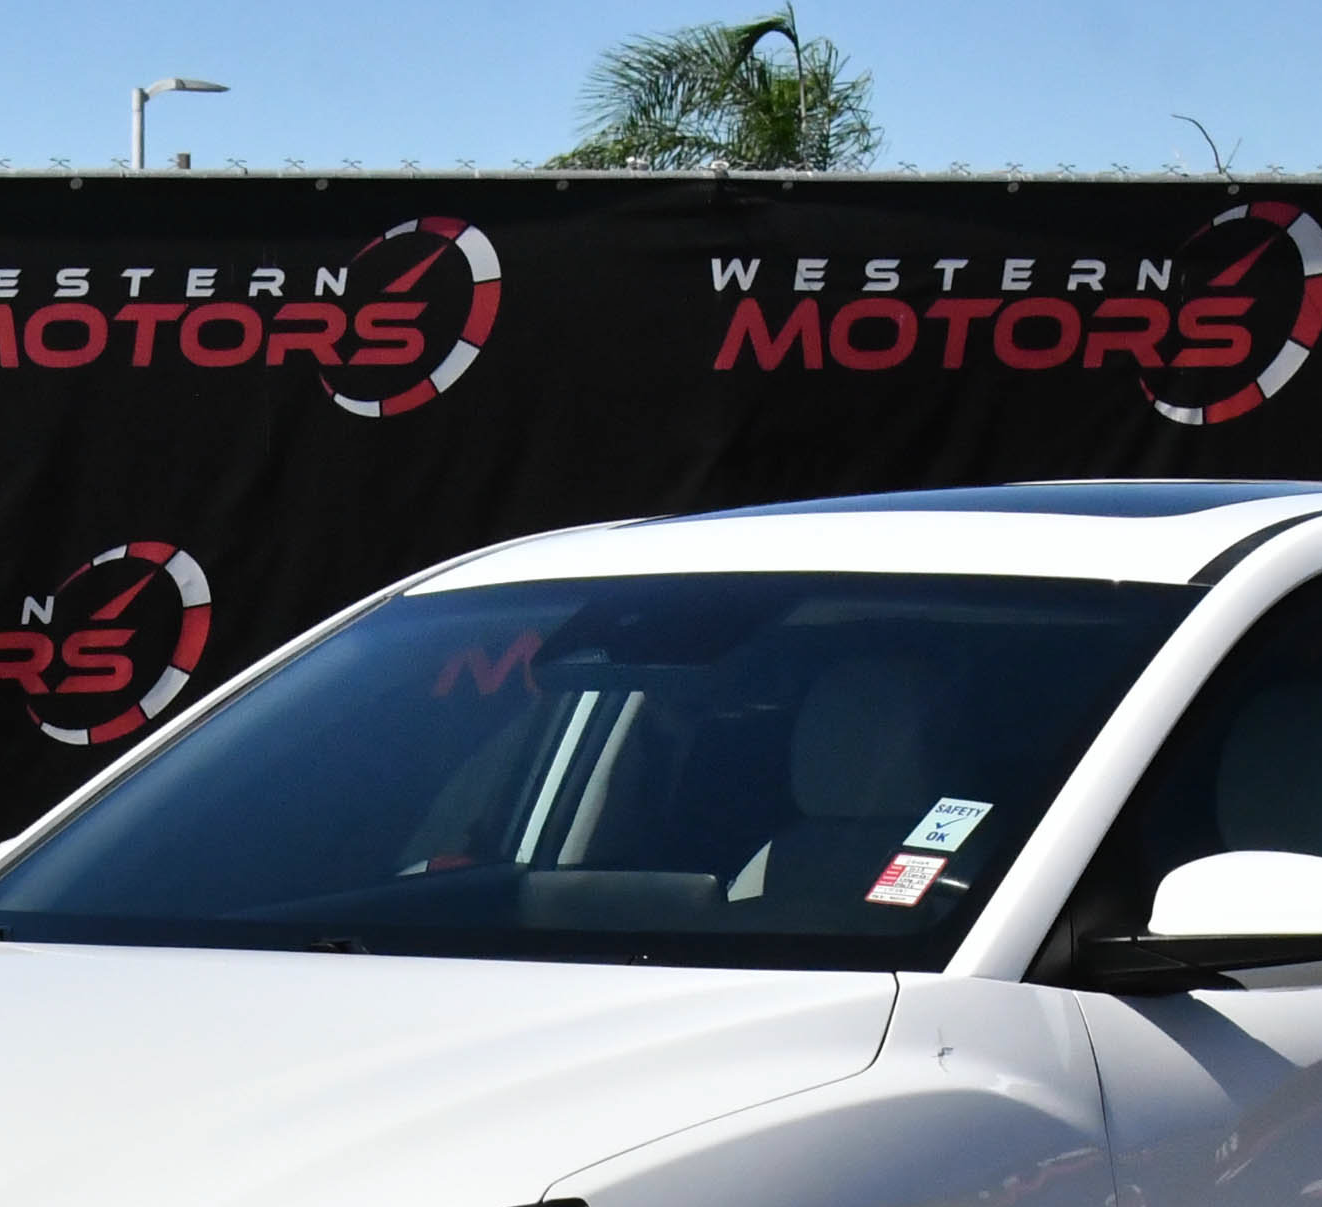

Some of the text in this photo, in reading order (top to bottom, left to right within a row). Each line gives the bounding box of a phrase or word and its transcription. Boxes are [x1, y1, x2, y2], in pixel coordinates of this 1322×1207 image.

[711, 258, 1172, 292] WESTERN
[714, 297, 1255, 370] MOTORS
[935, 803, 984, 819] SAFETY
[926, 831, 950, 843] OK
